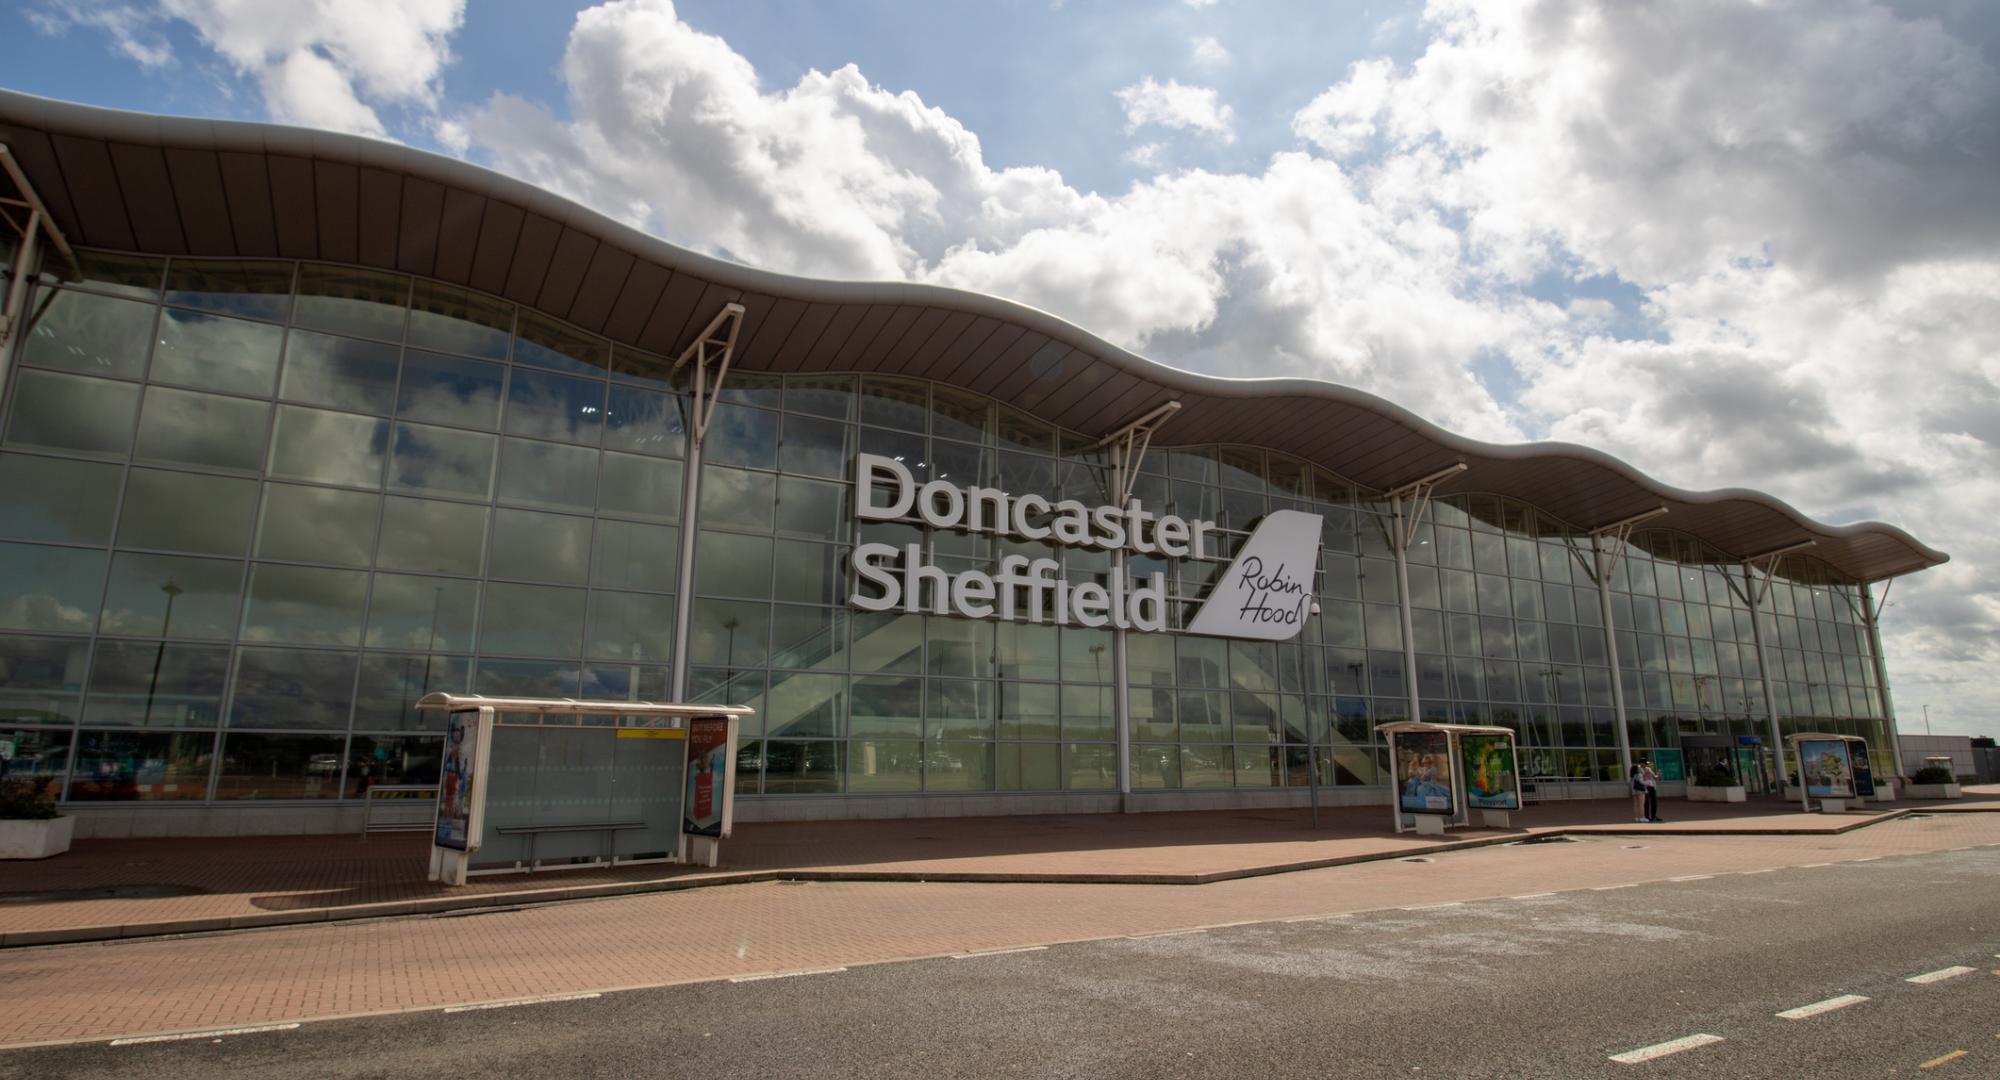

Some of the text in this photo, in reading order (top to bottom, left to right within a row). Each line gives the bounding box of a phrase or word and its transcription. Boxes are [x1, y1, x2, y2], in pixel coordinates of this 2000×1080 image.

[856, 452, 1215, 559] Doncaster
[850, 543, 1166, 632] Sheffield
[1239, 556, 1302, 594] Robin
[1239, 592, 1312, 629] Hood
